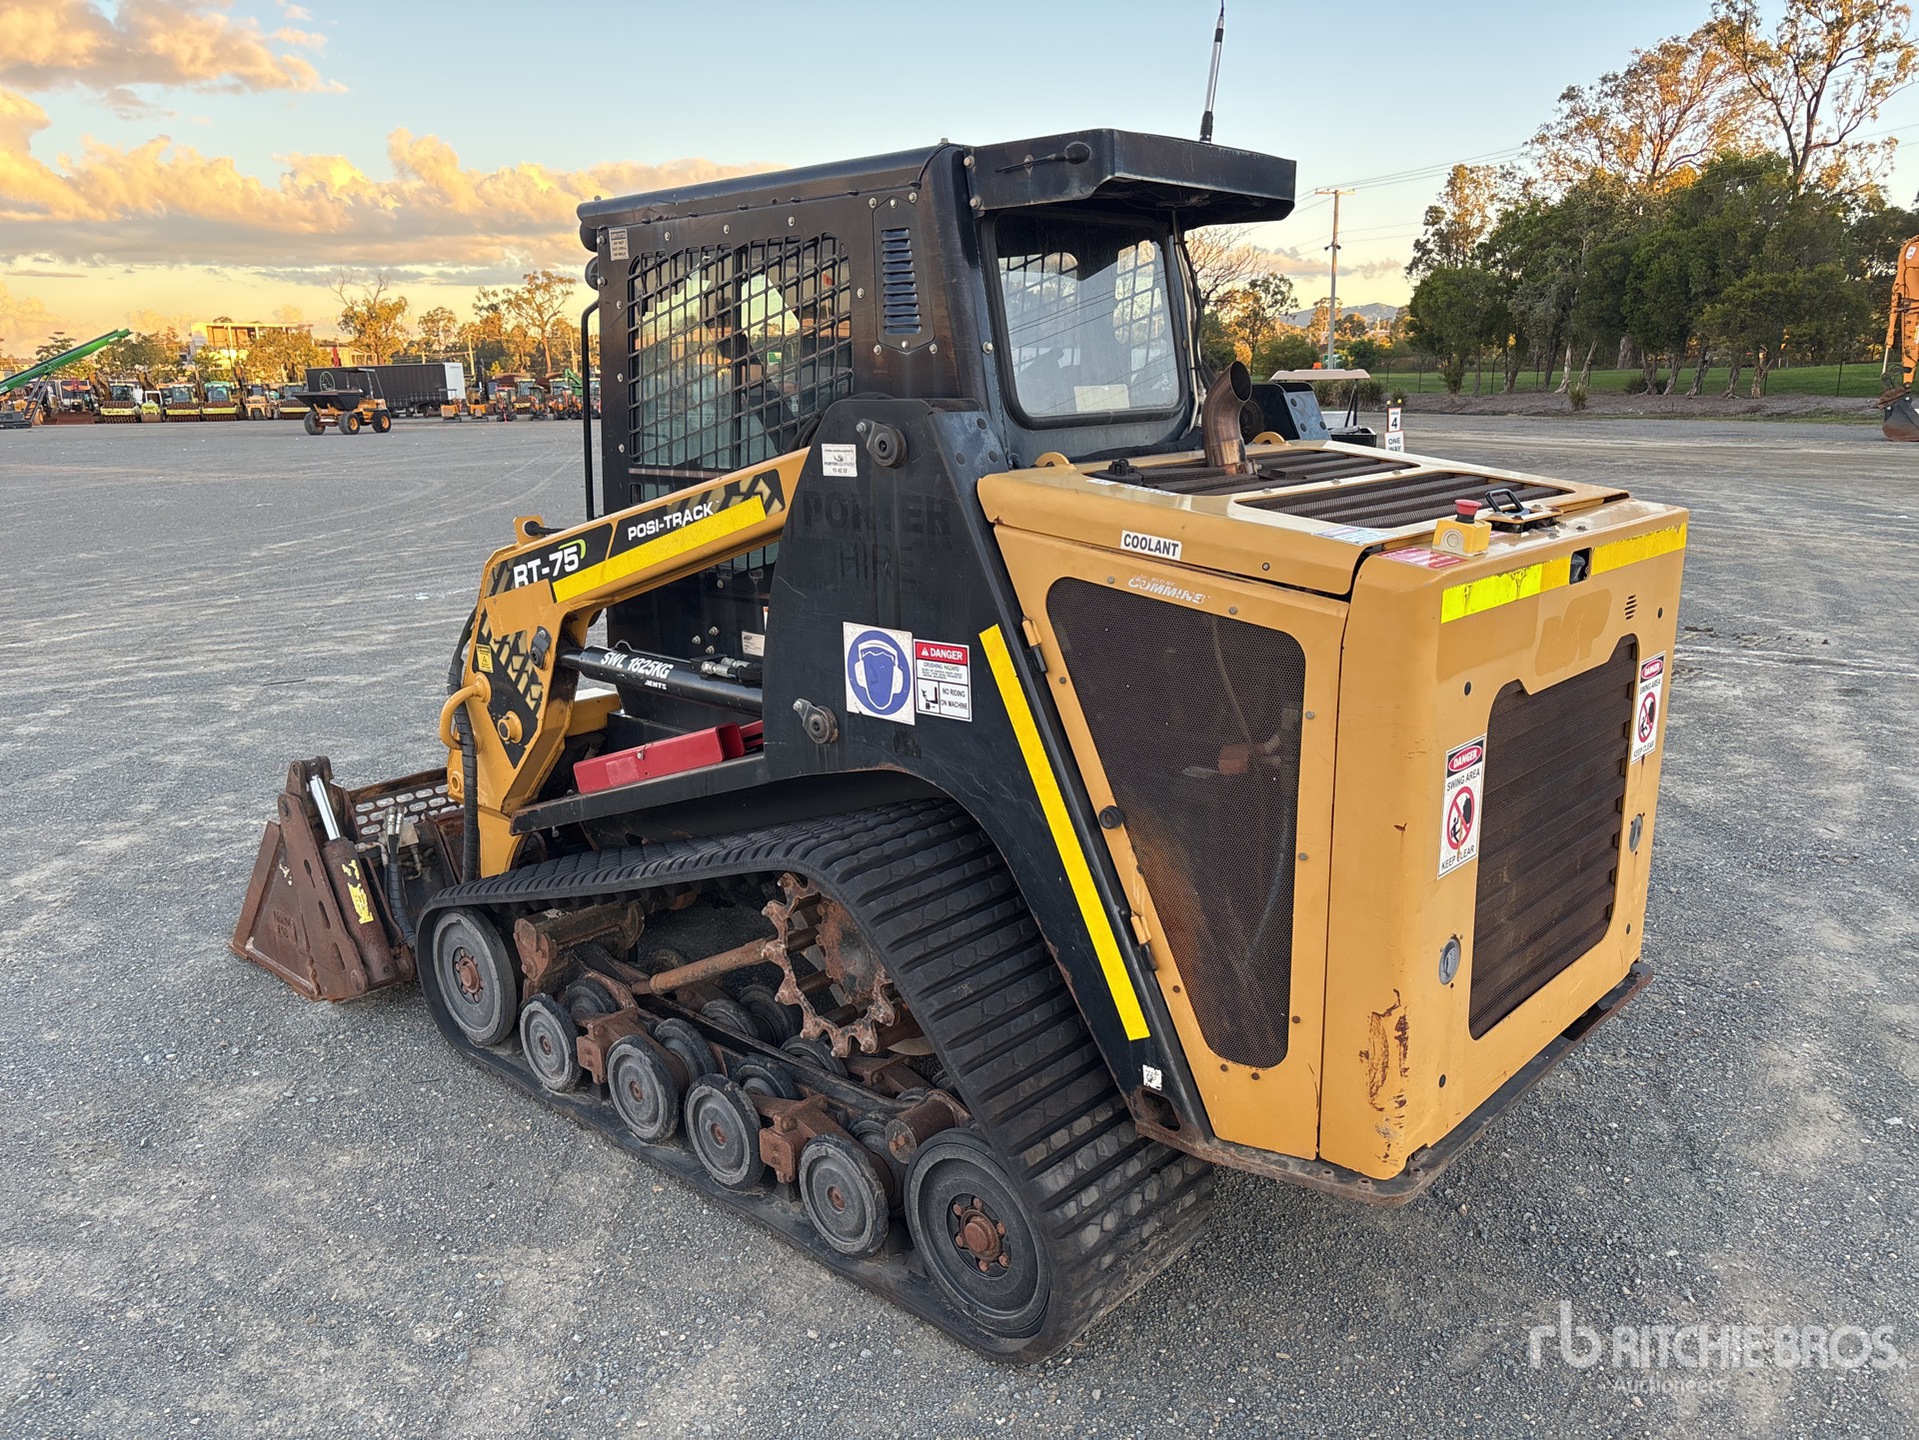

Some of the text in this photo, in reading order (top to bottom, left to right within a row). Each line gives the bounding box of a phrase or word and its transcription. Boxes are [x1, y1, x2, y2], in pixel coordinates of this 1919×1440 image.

[1391, 417, 1398, 429] 4
[1388, 437, 1400, 445] ONE
[627, 503, 714, 541] POSI-TRACK
[1123, 533, 1179, 557] COOLANT
[513, 545, 580, 589] RT-75
[930, 648, 963, 660] DANGER
[600, 651, 675, 680] SWL 1825KG
[942, 687, 965, 698] NO RIDING
[1639, 678, 1661, 694] SWING AREA
[948, 700, 968, 710] MACHINE
[1633, 740, 1654, 758] KEEP CLEAR
[1453, 748, 1478, 769] DANGER
[1446, 767, 1481, 792] SWING AREA
[1441, 855, 1456, 870] KEEP
